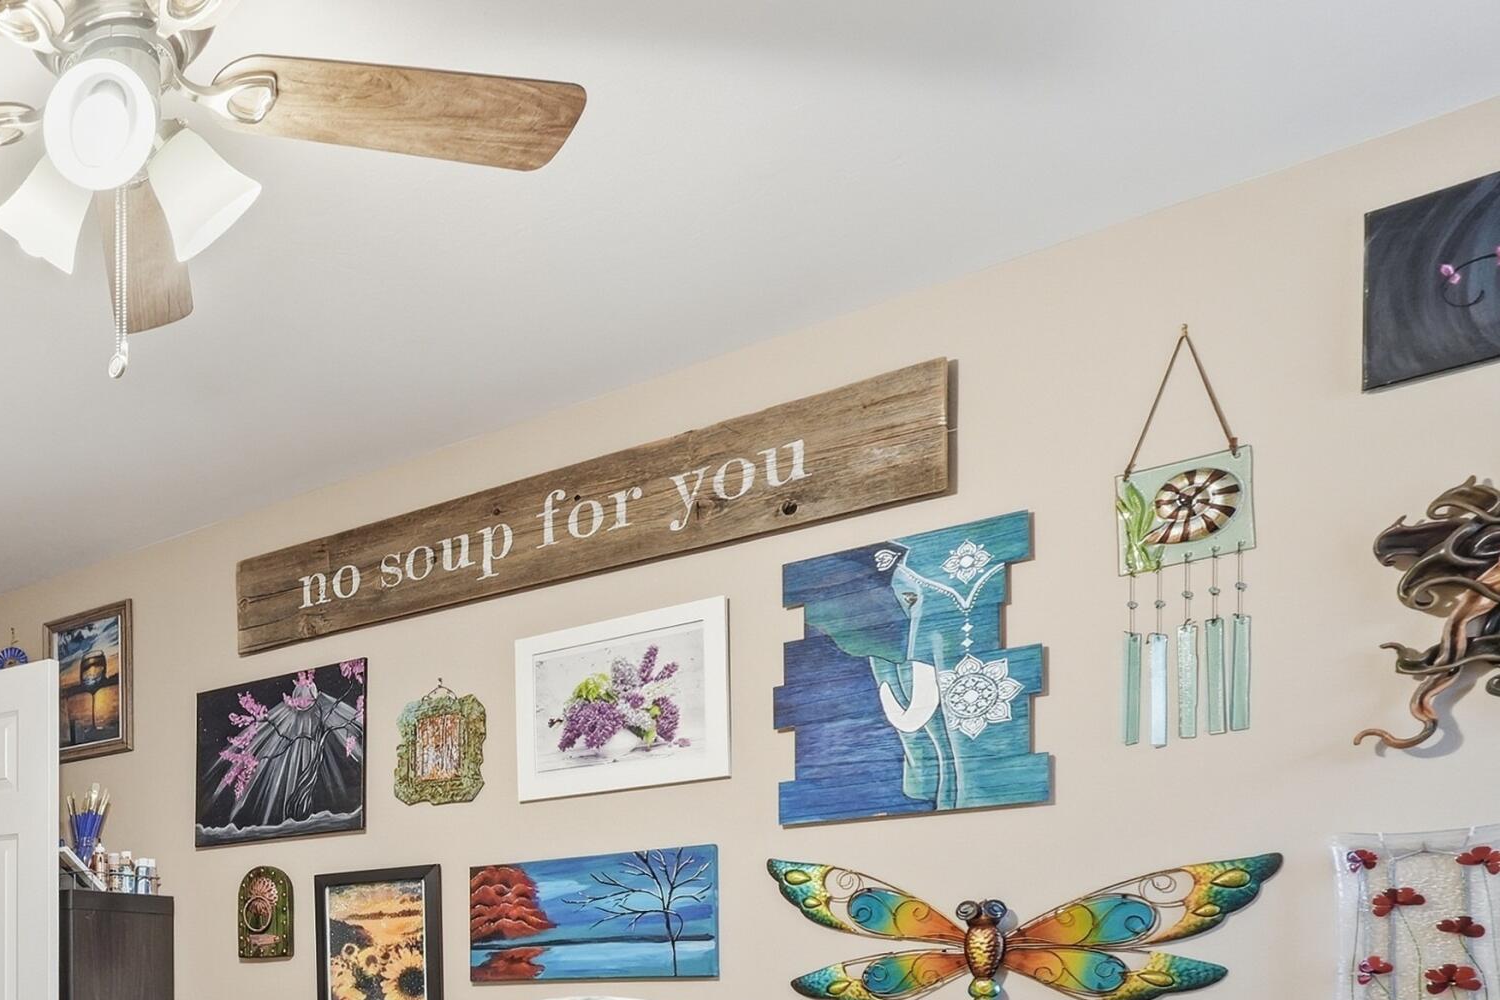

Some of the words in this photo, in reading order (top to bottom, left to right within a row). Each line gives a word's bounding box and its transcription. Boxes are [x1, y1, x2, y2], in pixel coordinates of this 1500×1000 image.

[298, 565, 362, 610] no
[379, 520, 514, 588] soup
[535, 487, 643, 549] for
[668, 438, 813, 532] you
